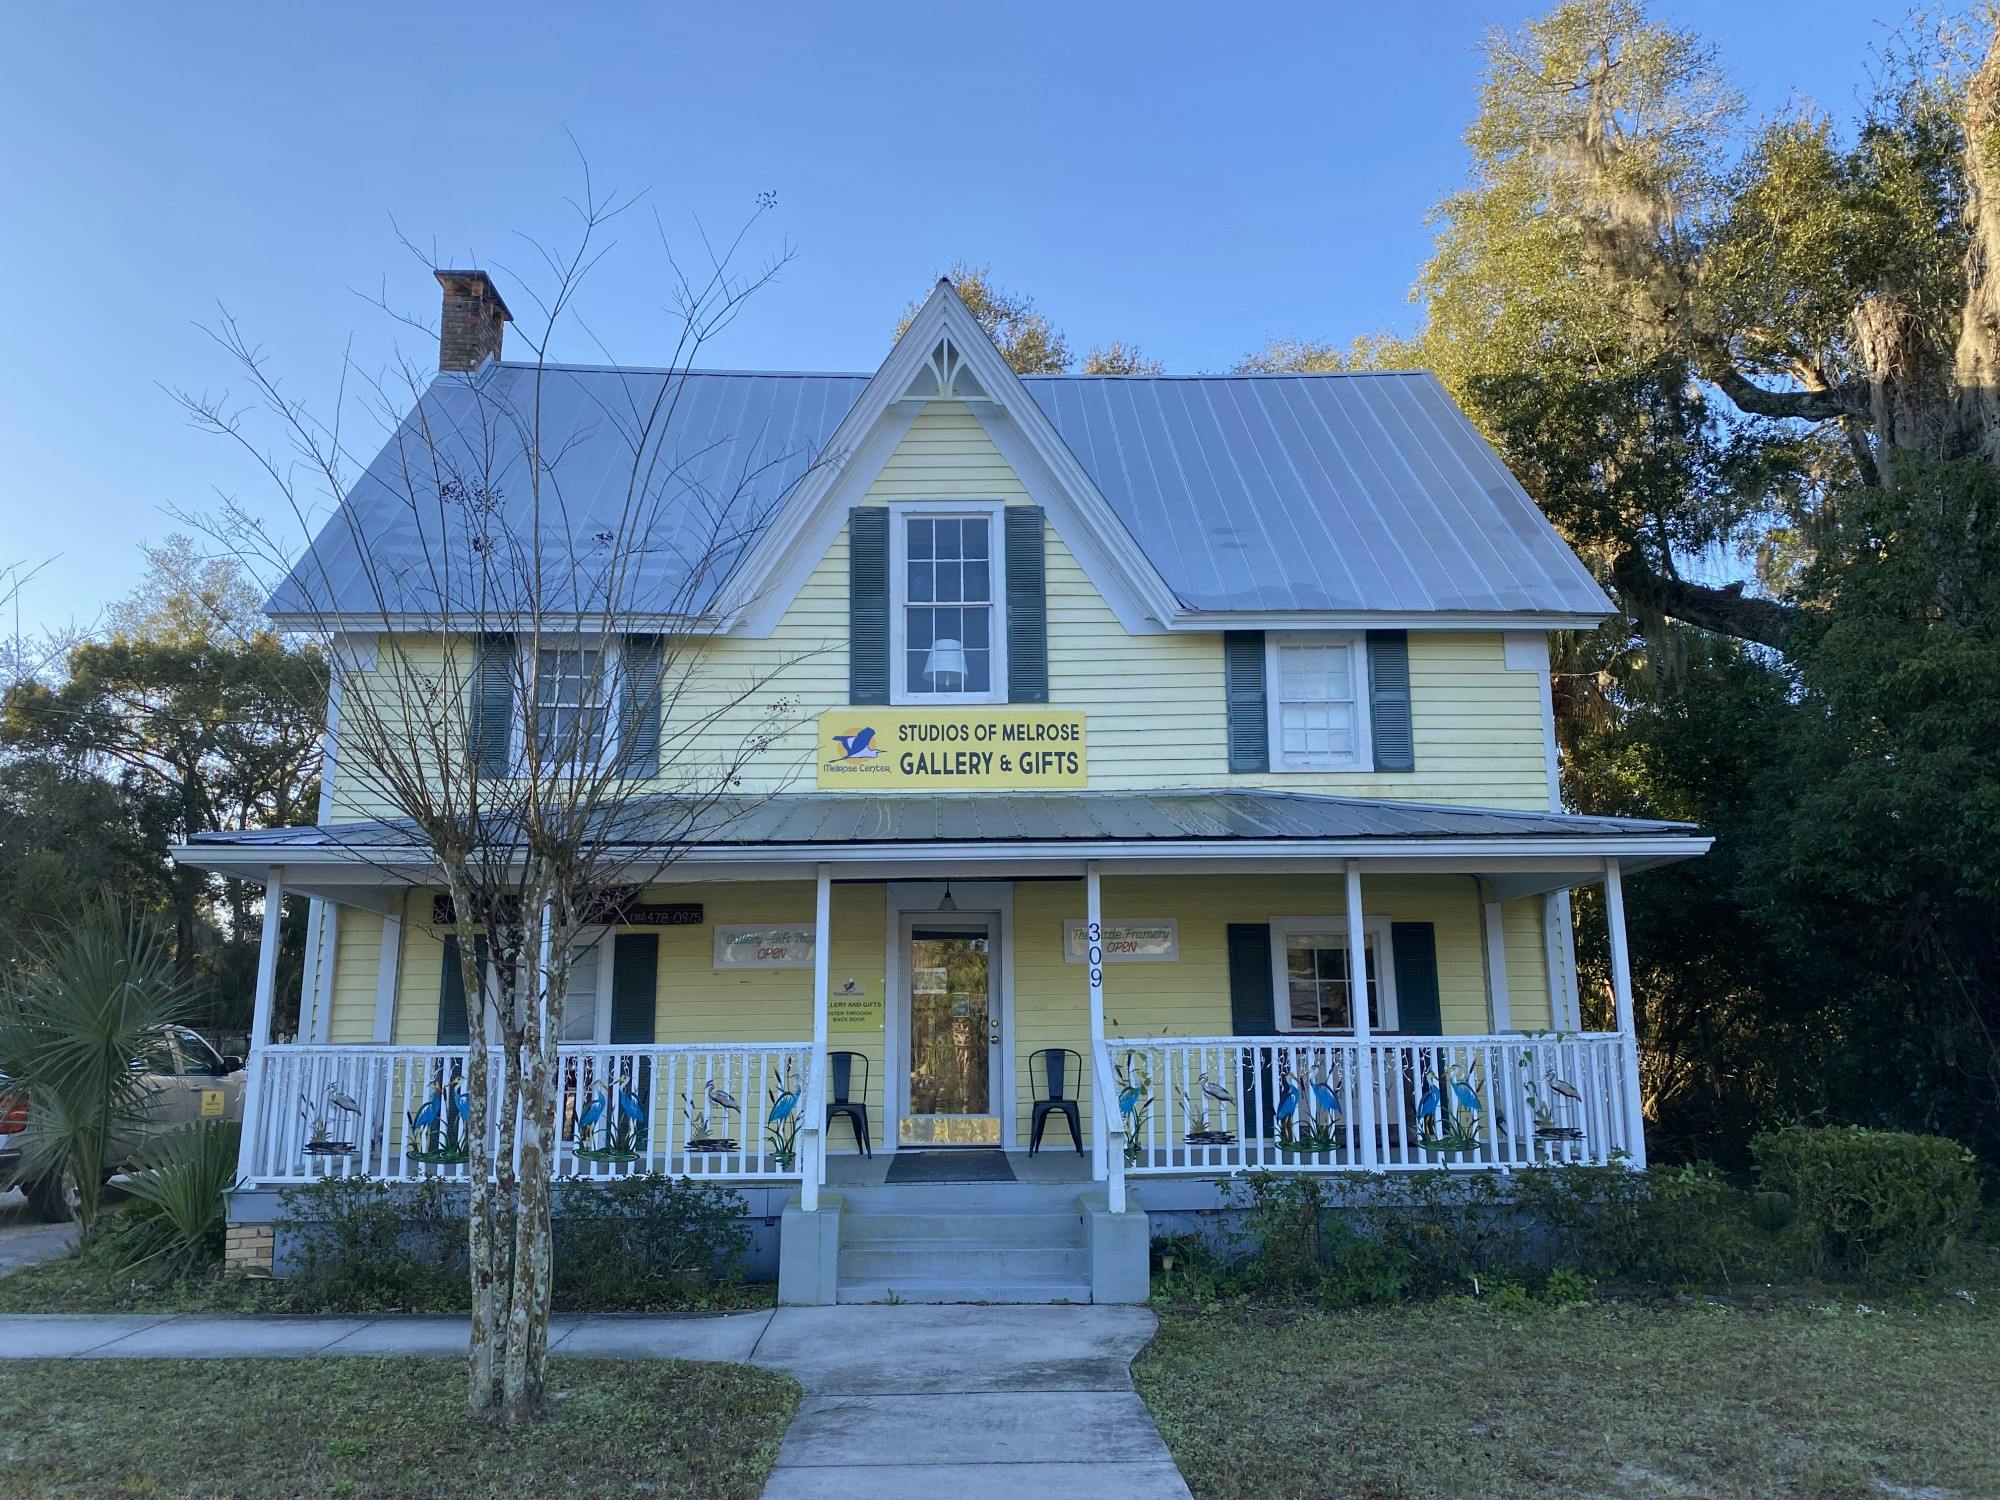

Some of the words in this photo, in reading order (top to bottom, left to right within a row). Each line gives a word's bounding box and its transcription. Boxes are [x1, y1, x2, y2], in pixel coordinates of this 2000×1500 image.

[898, 723, 969, 742] STUDIOS
[974, 723, 997, 742] OF
[1002, 723, 1080, 742] MELROSE
[900, 751, 994, 775] GALLERY
[1000, 754, 1013, 772] &
[1019, 751, 1079, 775] GIFTS
[1100, 928, 1121, 940] ittle
[1124, 928, 1170, 941] Framery
[757, 947, 786, 960] OPEN
[1089, 922, 1103, 988] 309
[1107, 941, 1137, 953] OPEN
